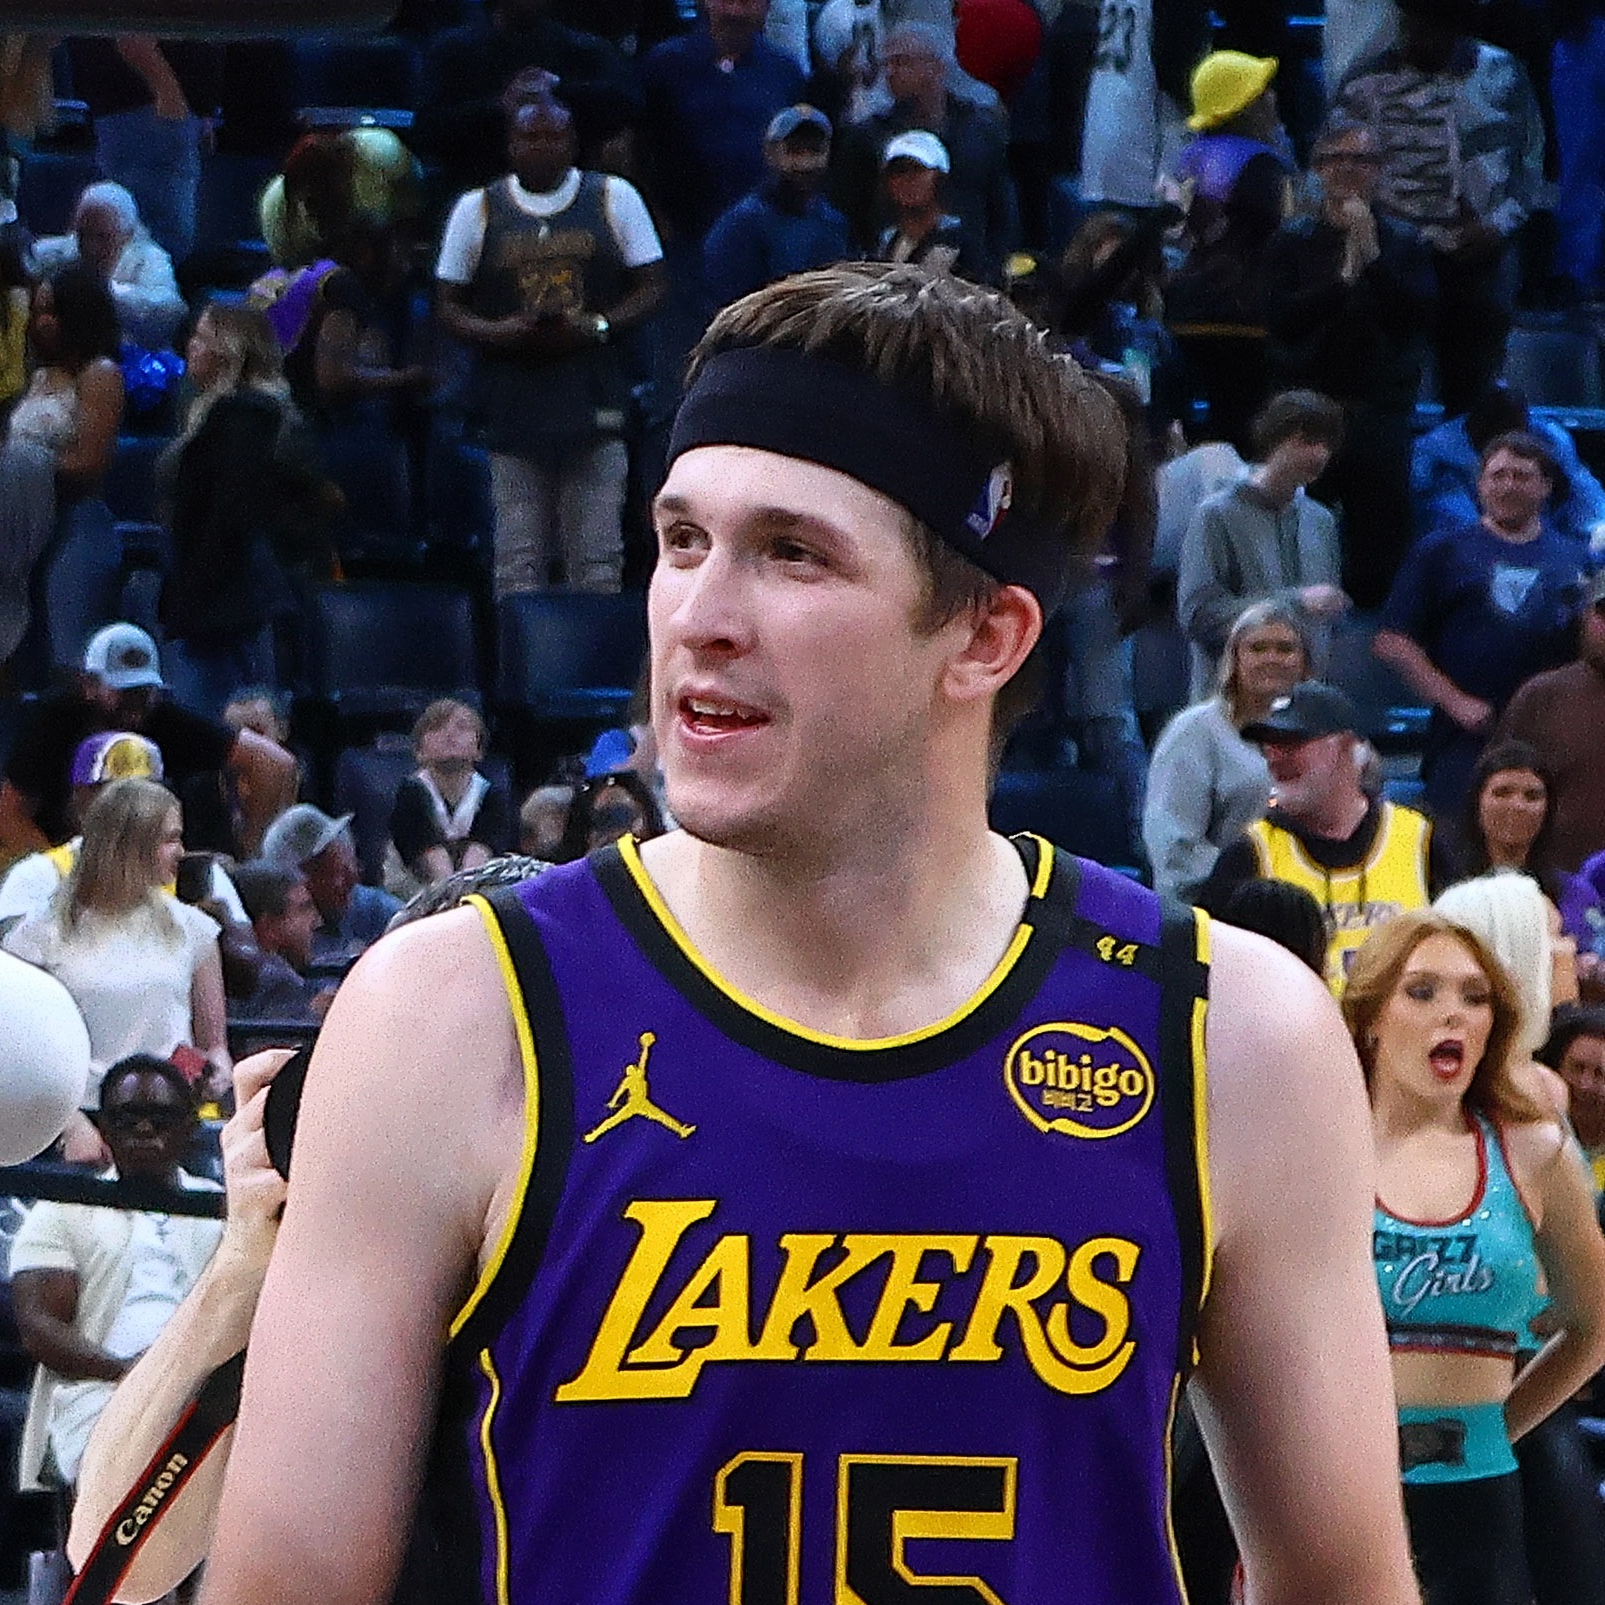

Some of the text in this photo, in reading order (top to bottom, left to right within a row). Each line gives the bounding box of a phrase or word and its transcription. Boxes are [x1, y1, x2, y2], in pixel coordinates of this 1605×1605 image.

[1019, 1049, 1145, 1107] bibigo
[554, 1199, 1143, 1401] LAKERS
[1393, 1251, 1495, 1319] Girls
[115, 1452, 188, 1546] Canon
